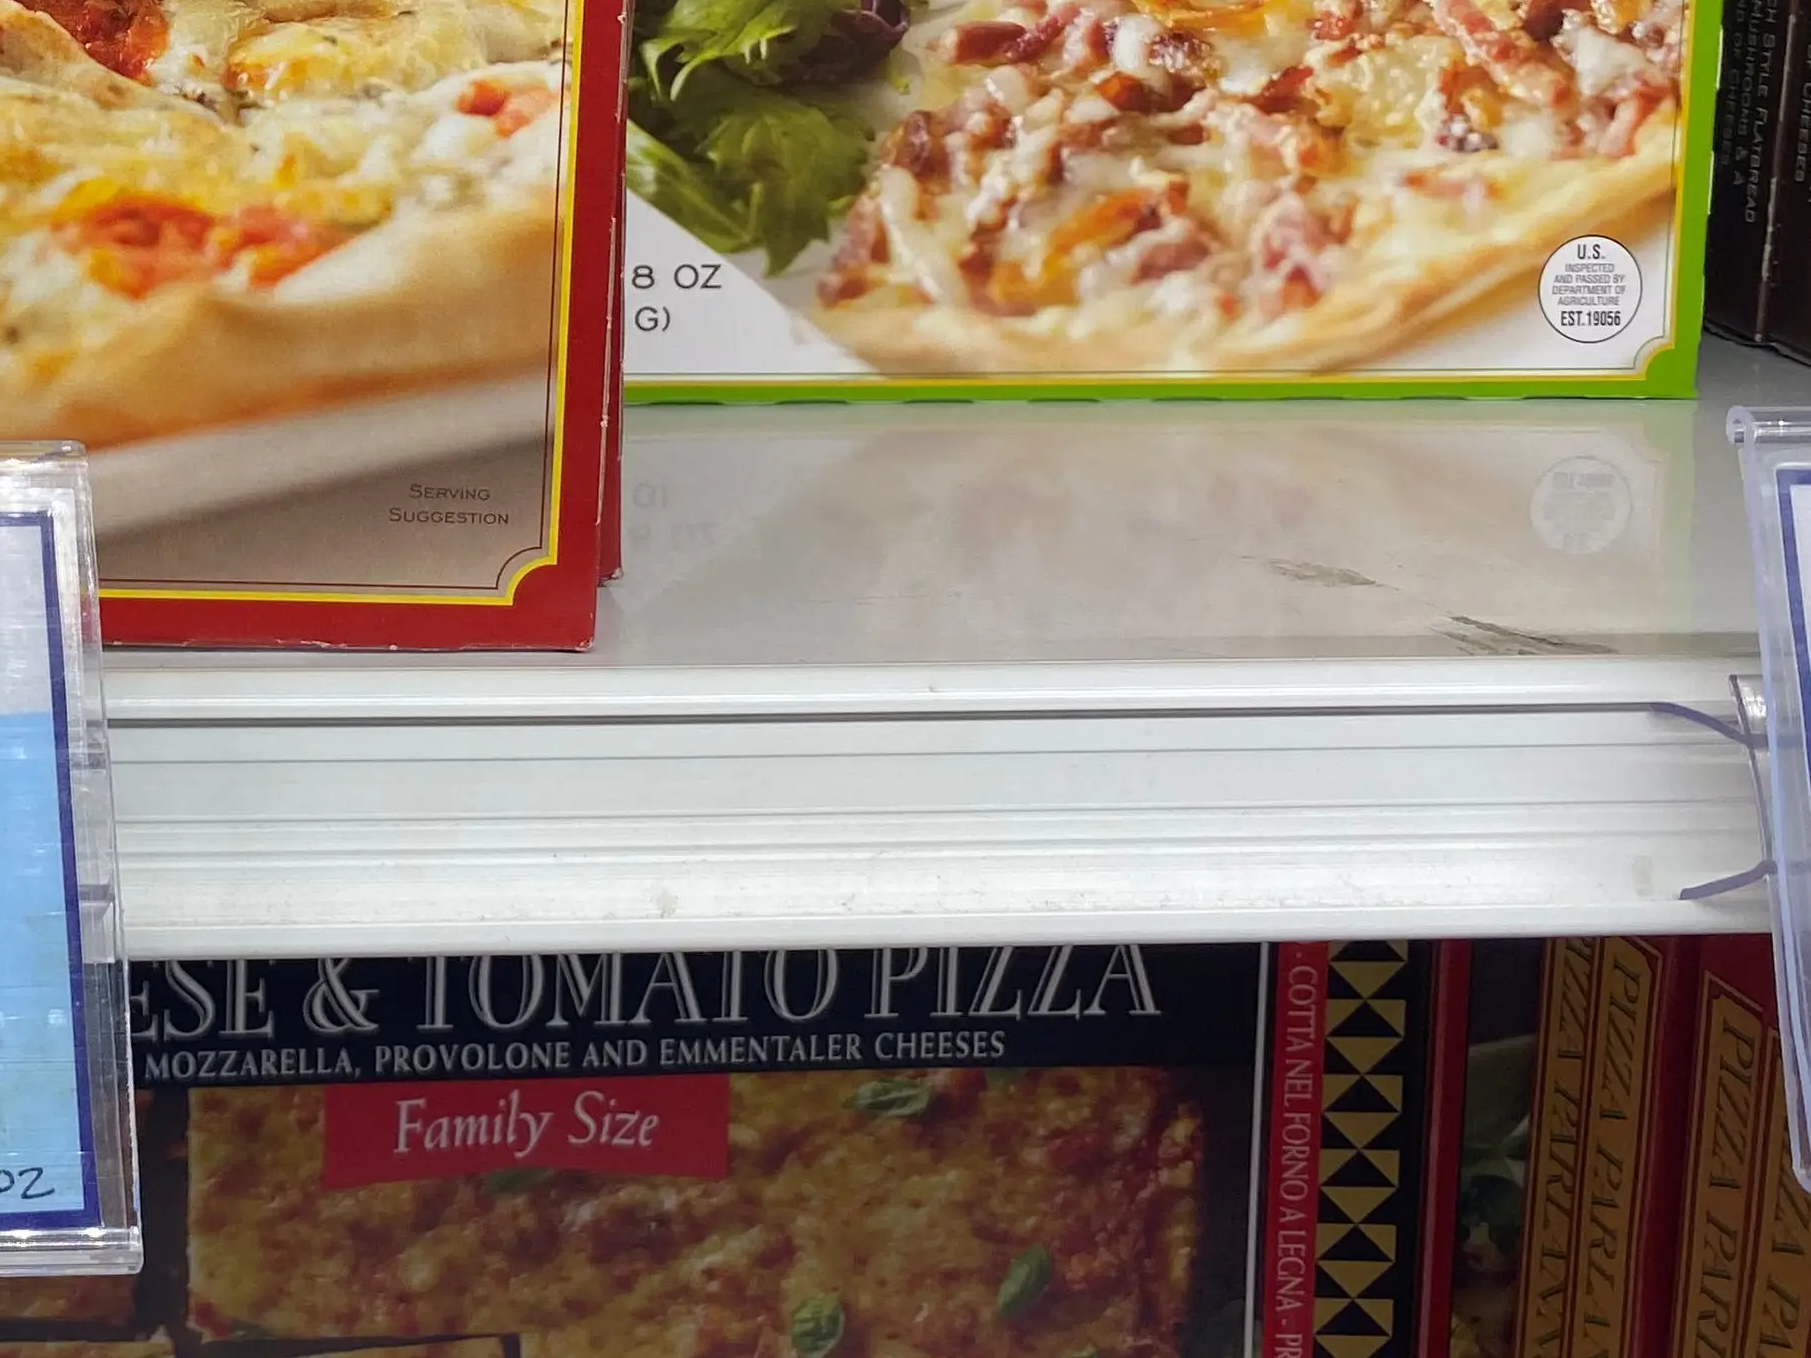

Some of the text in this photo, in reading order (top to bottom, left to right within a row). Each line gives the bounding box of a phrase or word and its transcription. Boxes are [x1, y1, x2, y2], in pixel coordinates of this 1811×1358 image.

[1577, 243, 1606, 260] U.S.
[673, 263, 723, 290] OZ
[1553, 274, 1626, 284] AND PASSED BY
[1564, 262, 1616, 273] INSPECTED
[1551, 285, 1627, 295] DEPARTMENT OF
[1557, 296, 1621, 306] AGRICULTURE
[408, 483, 492, 502] SERVING
[389, 507, 510, 525] SUGGESTION
[302, 956, 380, 1034] &
[407, 948, 841, 1030] TOMATO
[863, 942, 1162, 1021] PIZZA
[1284, 965, 1319, 1053] COTTA
[145, 1030, 1007, 1081] MOZZARELLA, PROVOLONE AND EMMENTALER CHEESES
[1283, 1058, 1314, 1108] NEL
[393, 1089, 661, 1159] Family Size
[1279, 1112, 1311, 1202] FORNO
[1278, 1206, 1307, 1224] A
[1274, 1230, 1307, 1313] LEGNA
